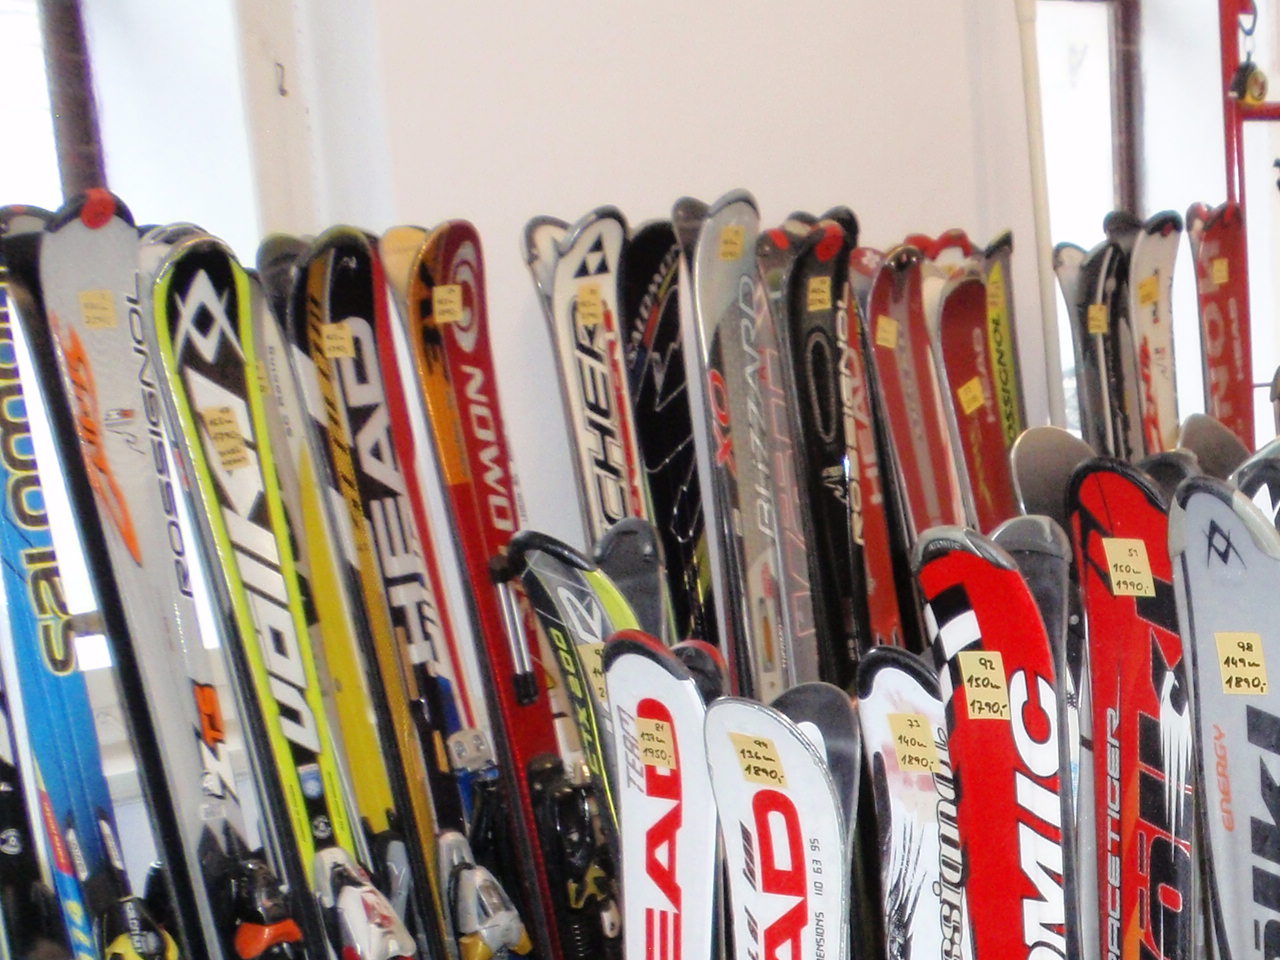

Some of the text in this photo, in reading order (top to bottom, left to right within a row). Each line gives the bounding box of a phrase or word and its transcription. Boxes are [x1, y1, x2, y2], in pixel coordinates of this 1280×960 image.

[738, 273, 778, 538] BLIZZARD
[992, 316, 1019, 444] OSSIGNOL
[125, 272, 194, 599] ROSSIGNOL
[978, 657, 997, 672] 92
[1237, 641, 1254, 653] 98
[617, 704, 645, 793] TEAM
[812, 857, 824, 876] 63
[813, 879, 825, 897] 110
